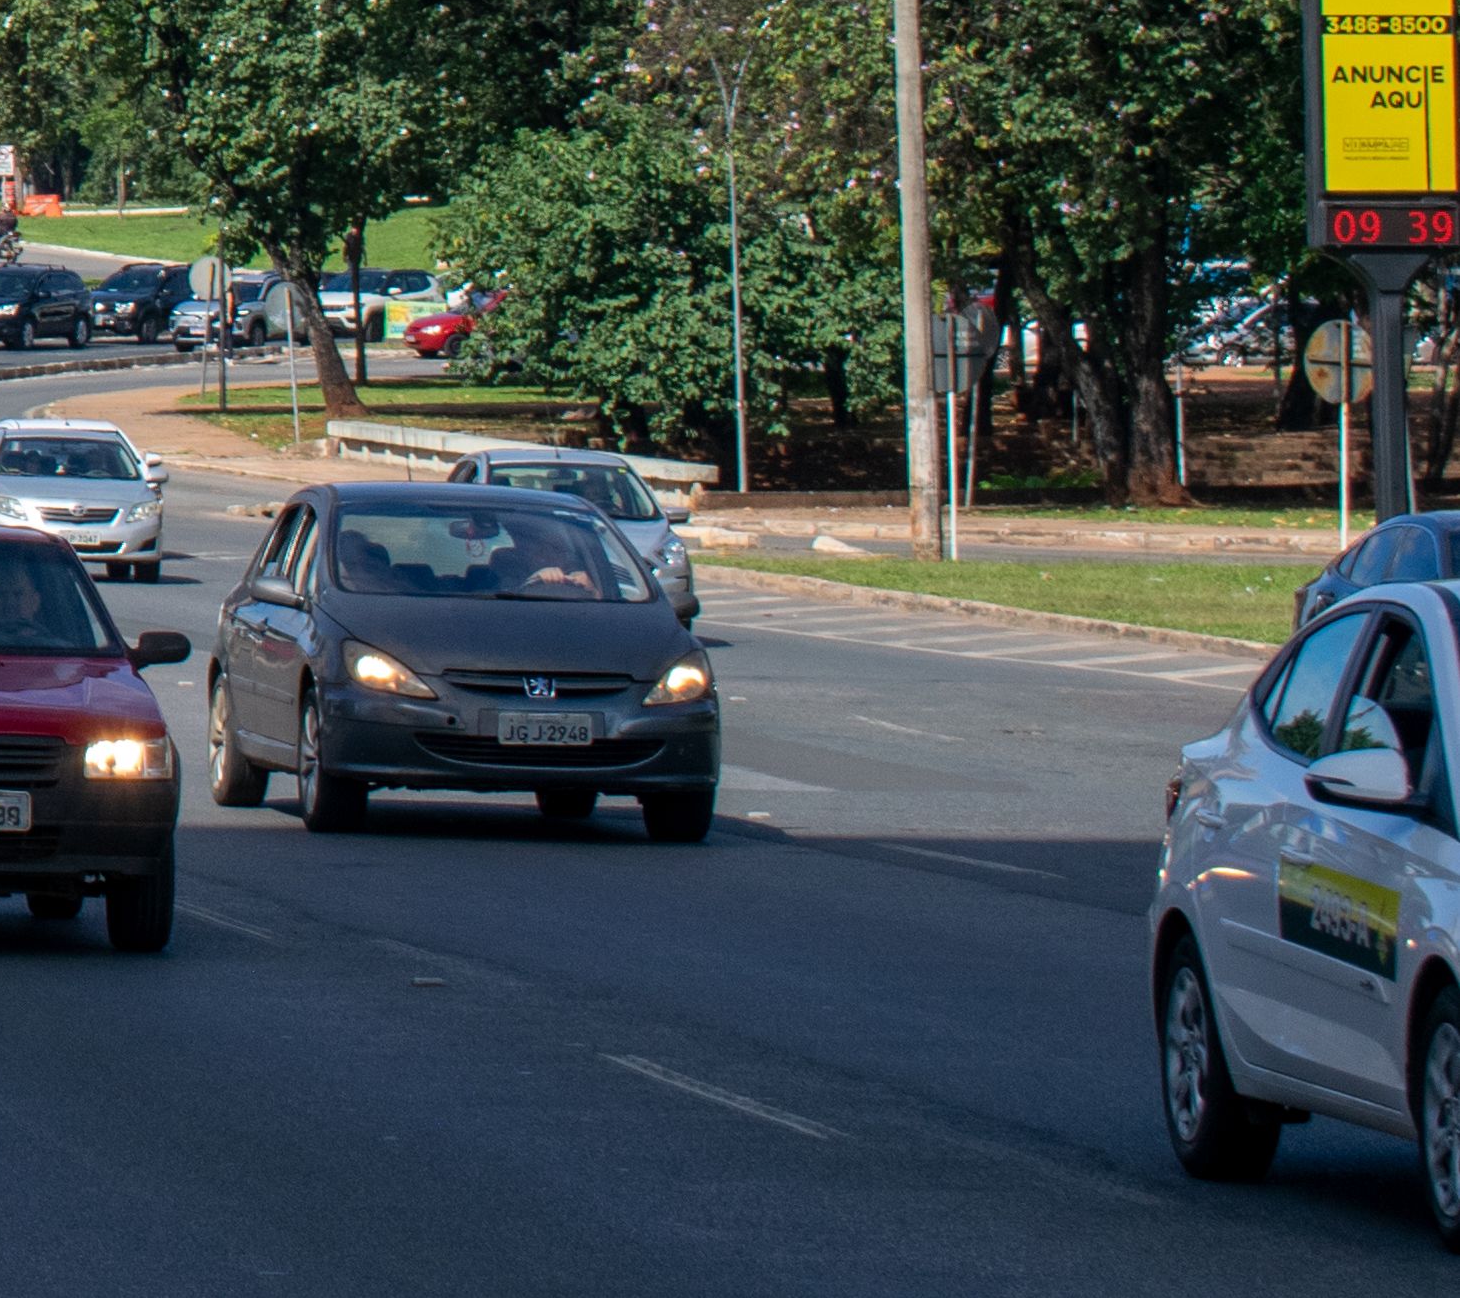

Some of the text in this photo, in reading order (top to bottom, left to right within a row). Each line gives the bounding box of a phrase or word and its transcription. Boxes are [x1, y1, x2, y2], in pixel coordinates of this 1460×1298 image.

[1326, 16, 1448, 34] 3486-8500
[1332, 65, 1445, 84] ANUNCIE
[1334, 209, 1454, 244] 09 39
